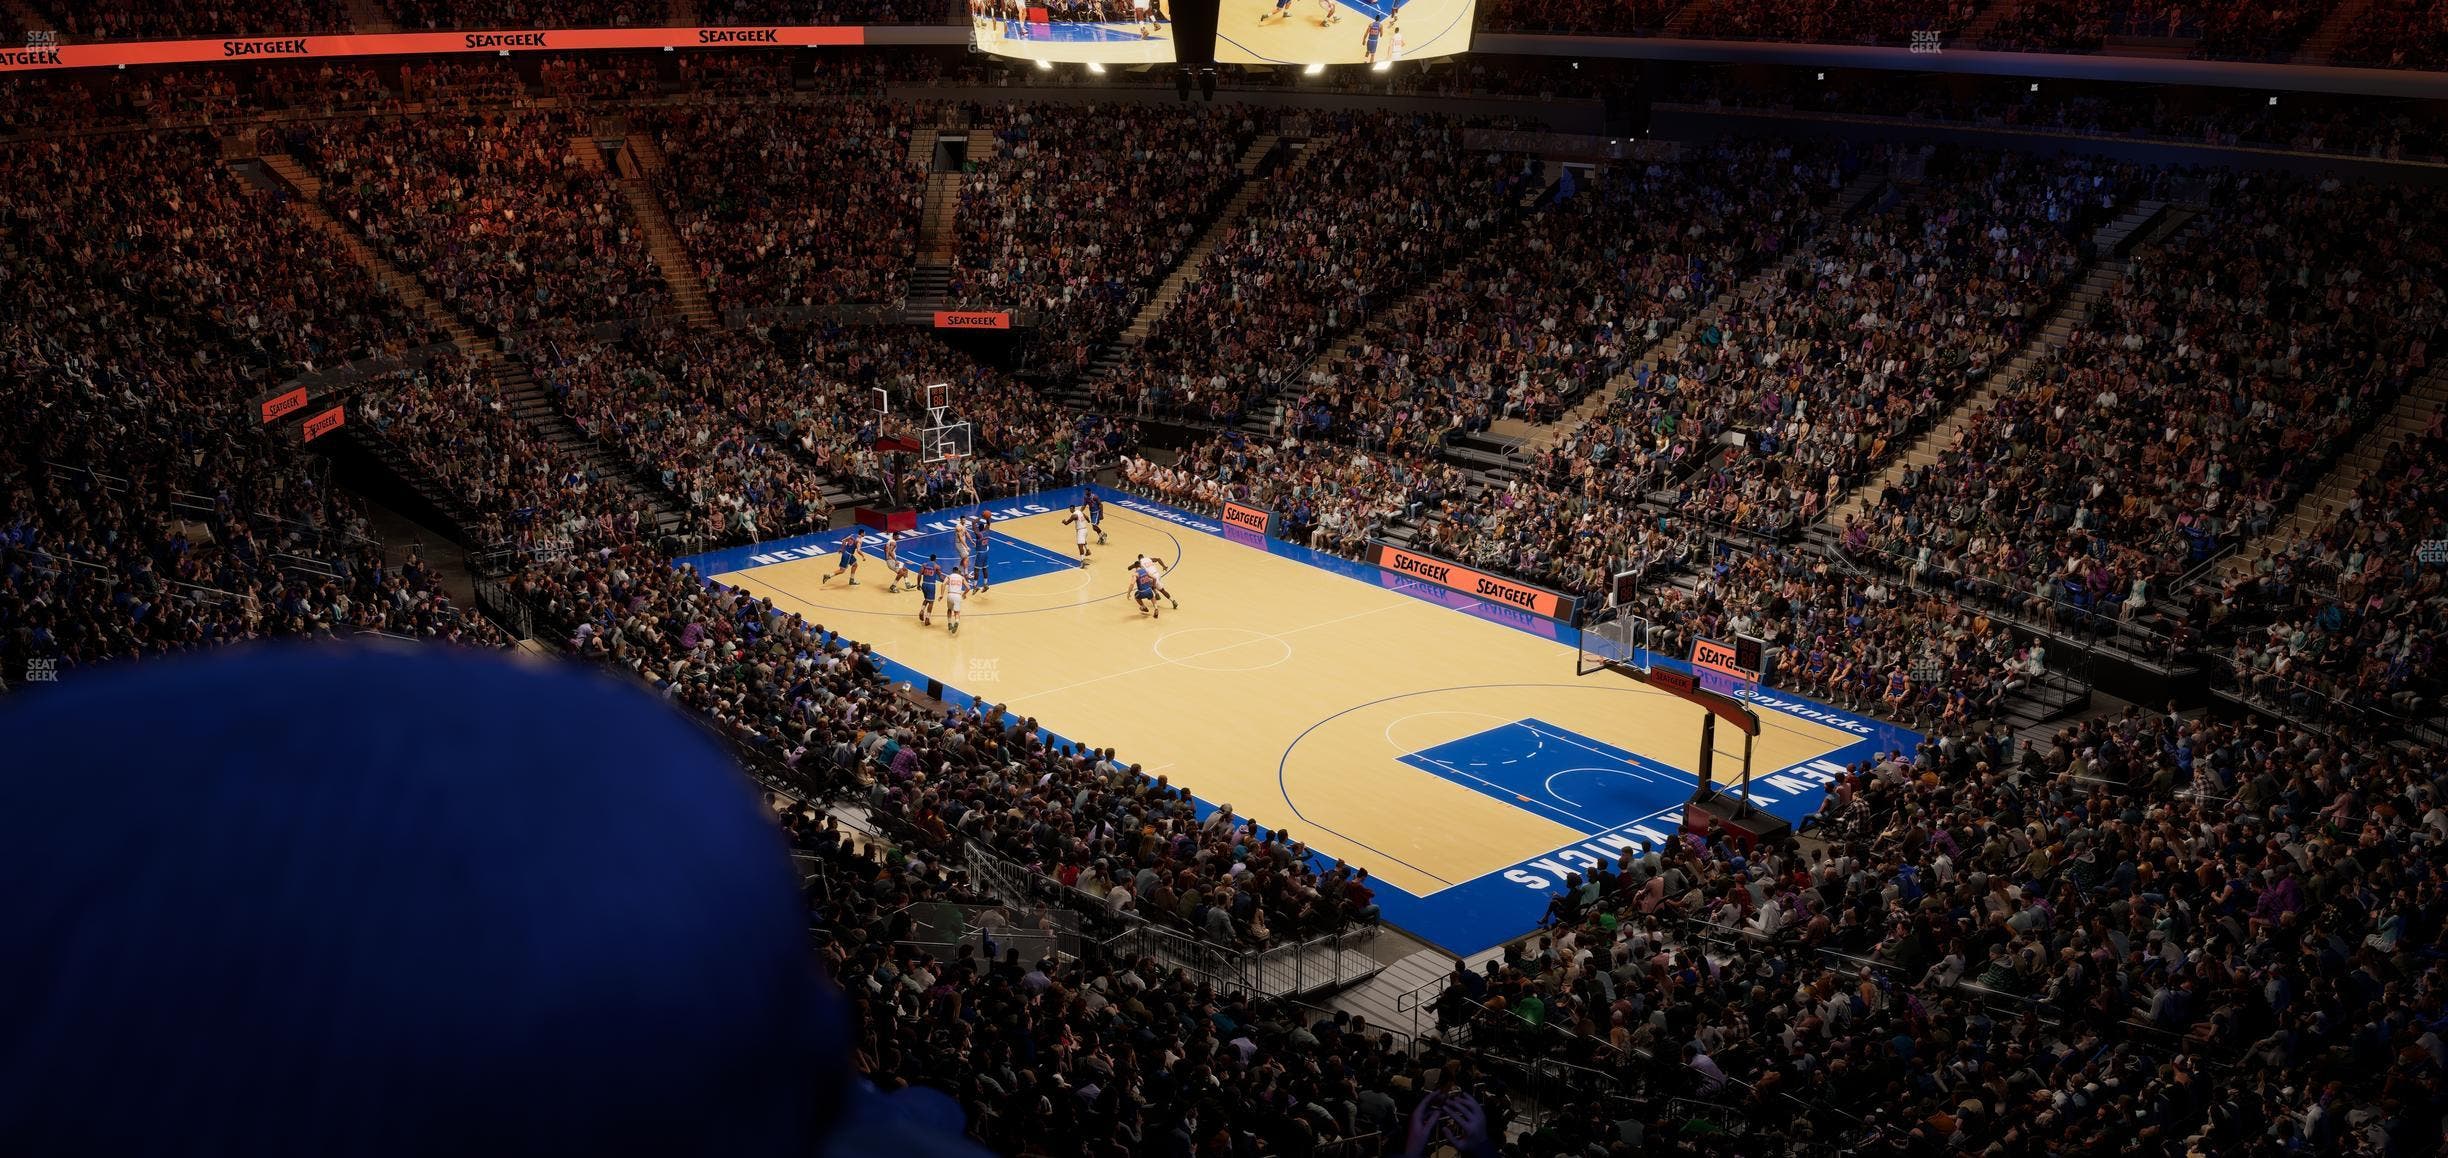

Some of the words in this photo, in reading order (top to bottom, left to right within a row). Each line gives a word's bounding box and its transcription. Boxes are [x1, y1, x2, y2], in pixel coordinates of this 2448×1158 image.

[465, 32, 547, 48] SEATGEEK
[699, 29, 778, 43] SEATGEEK
[223, 39, 308, 56] SEATGEEK
[947, 316, 997, 326] SEATGEEK
[269, 395, 300, 415] SEATGEEK
[1226, 507, 1266, 530] SEATGEEK
[750, 544, 827, 564] NEW
[1393, 554, 1450, 583] SEATGEEK
[1476, 578, 1537, 609] SEATGEEK
[1733, 689, 1874, 734] @nyknicks
